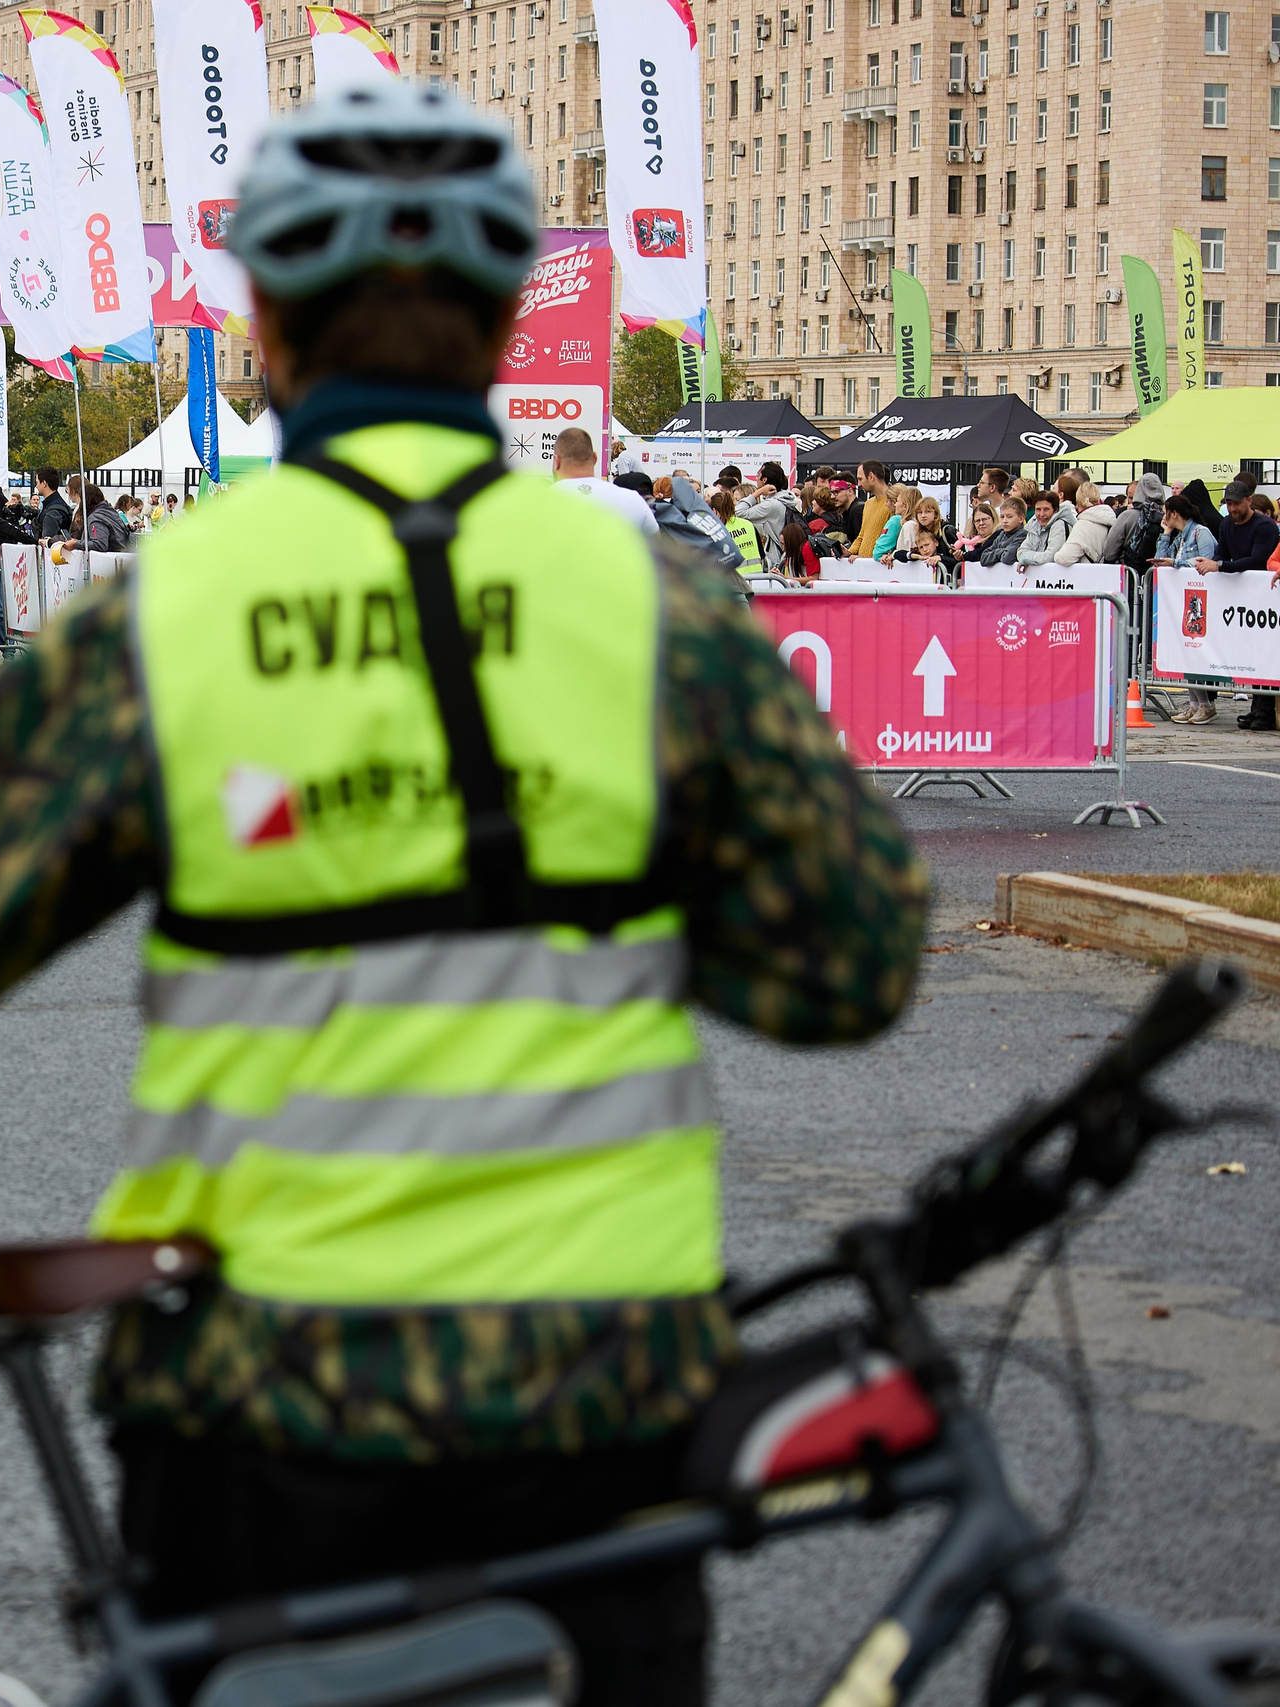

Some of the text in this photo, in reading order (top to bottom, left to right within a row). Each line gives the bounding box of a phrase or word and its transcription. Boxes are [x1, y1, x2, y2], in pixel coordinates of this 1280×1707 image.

[521, 241, 594, 285] обрый
[561, 340, 590, 351] ДЕТИ
[503, 354, 536, 369] ПРОЕКТЫ
[558, 351, 592, 361] НАШИ
[508, 398, 582, 420] BBDO
[856, 425, 972, 443] SUPERSPORT
[1080, 465, 1095, 475] AON
[1212, 464, 1233, 473] BAON
[997, 613, 1027, 628] ДОБРЫЕ
[1237, 606, 1280, 630] Toob
[248, 581, 516, 679] СУДЯ
[1050, 621, 1079, 632] ДЕТИ
[995, 636, 1028, 651] ПРОЕКТЫ
[1048, 632, 1080, 642] НАШИ
